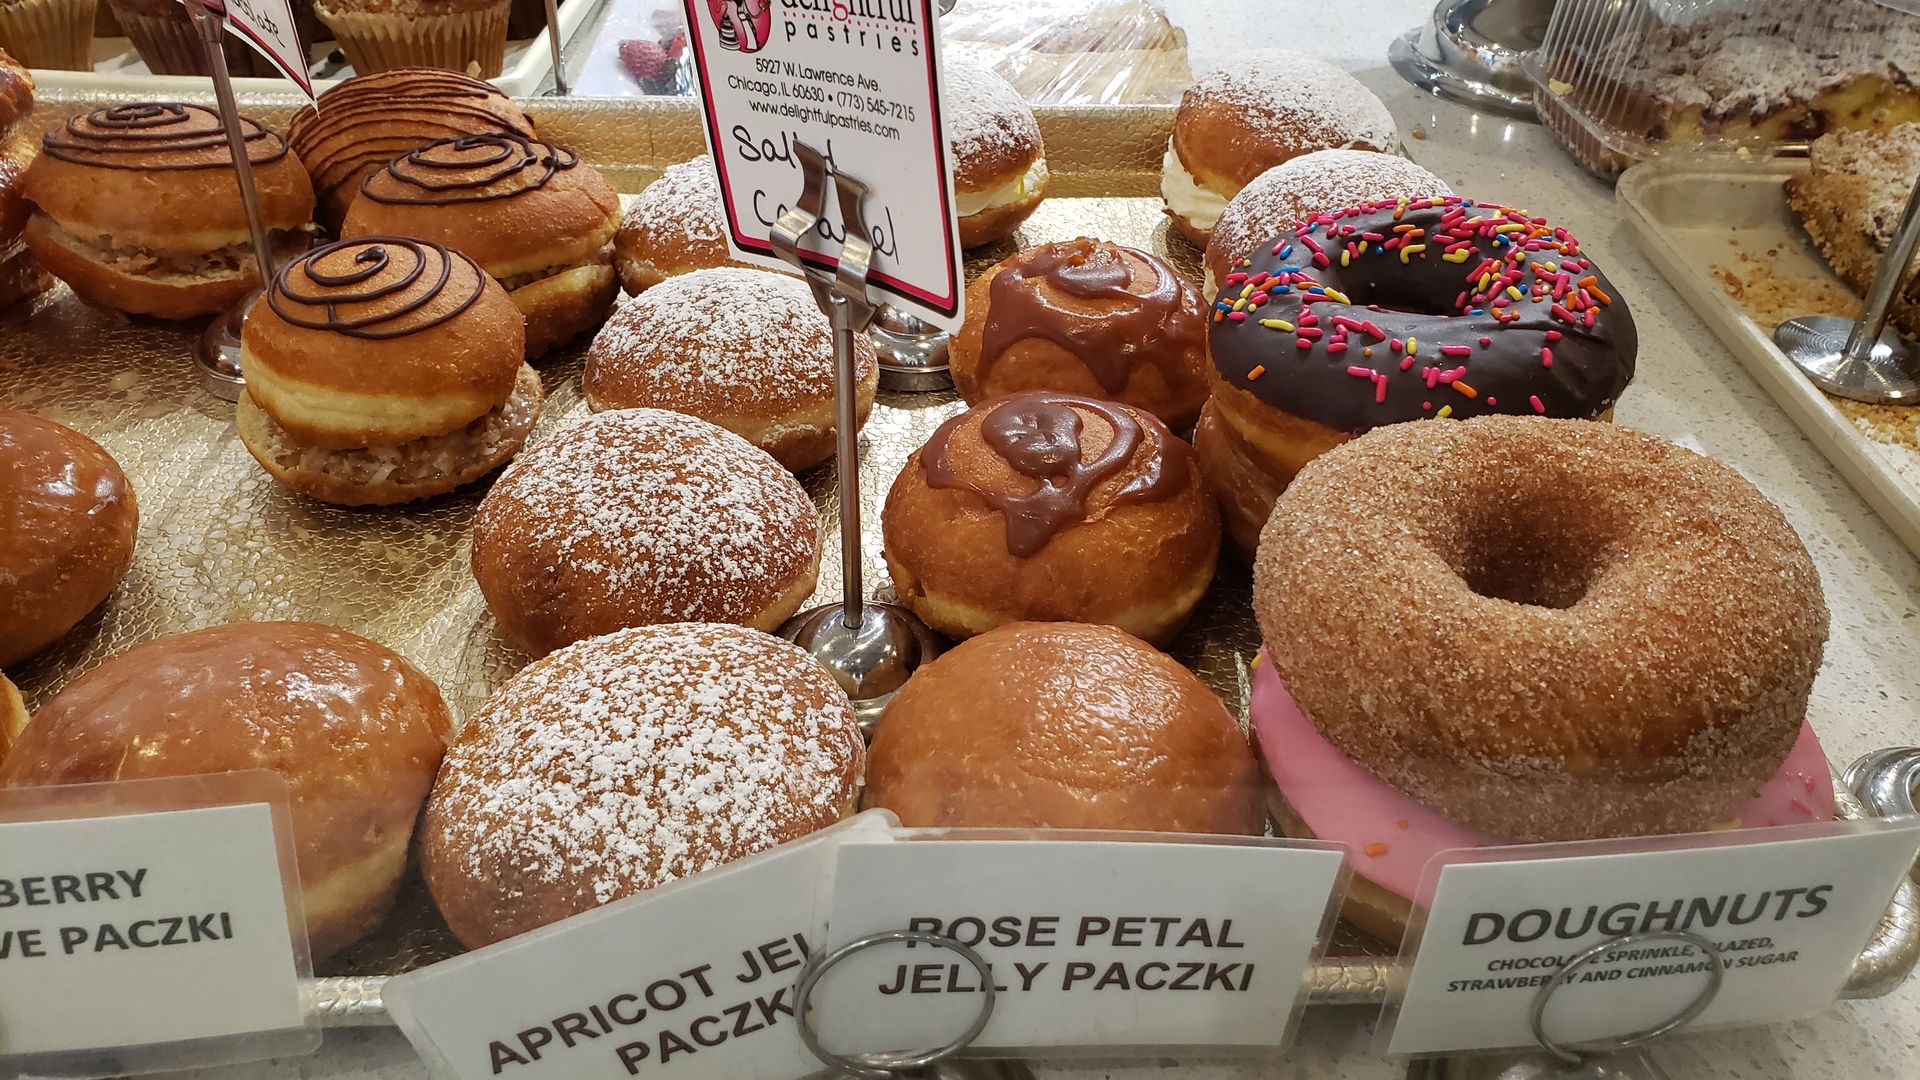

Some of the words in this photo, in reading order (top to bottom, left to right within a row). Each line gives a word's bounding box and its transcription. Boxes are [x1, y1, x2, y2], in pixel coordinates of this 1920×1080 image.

[781, 0, 916, 24] ghtful
[784, 21, 919, 56] pastries
[755, 58, 781, 75] 5927
[782, 62, 797, 77] W.
[799, 64, 855, 87] Lawrence
[857, 73, 882, 92] Ave.
[749, 99, 901, 141] www.delightfulpastries.com
[792, 84, 825, 103] 60630
[837, 91, 865, 112] (773)
[867, 97, 916, 123] 545-7215
[732, 124, 838, 177] Sald
[753, 189, 900, 265] Cael
[0, 868, 147, 907] BERRY
[59, 912, 233, 955] PACZKI
[907, 916, 1060, 949] ROSE
[1075, 917, 1245, 948] PETAL
[1462, 884, 1833, 945] DOUGHNUTS
[878, 962, 1049, 995] JELLY
[1062, 961, 1255, 992] PACZKI
[1447, 972, 1578, 993] STRAWBERY
[1579, 970, 1622, 984] AND
[1735, 951, 1799, 969] SUGAR
[1487, 953, 1600, 972] CHOCOLE
[1604, 944, 1695, 964] SPRINKLE,
[488, 963, 713, 1075] APRICOT
[615, 983, 796, 1075] PACZK
